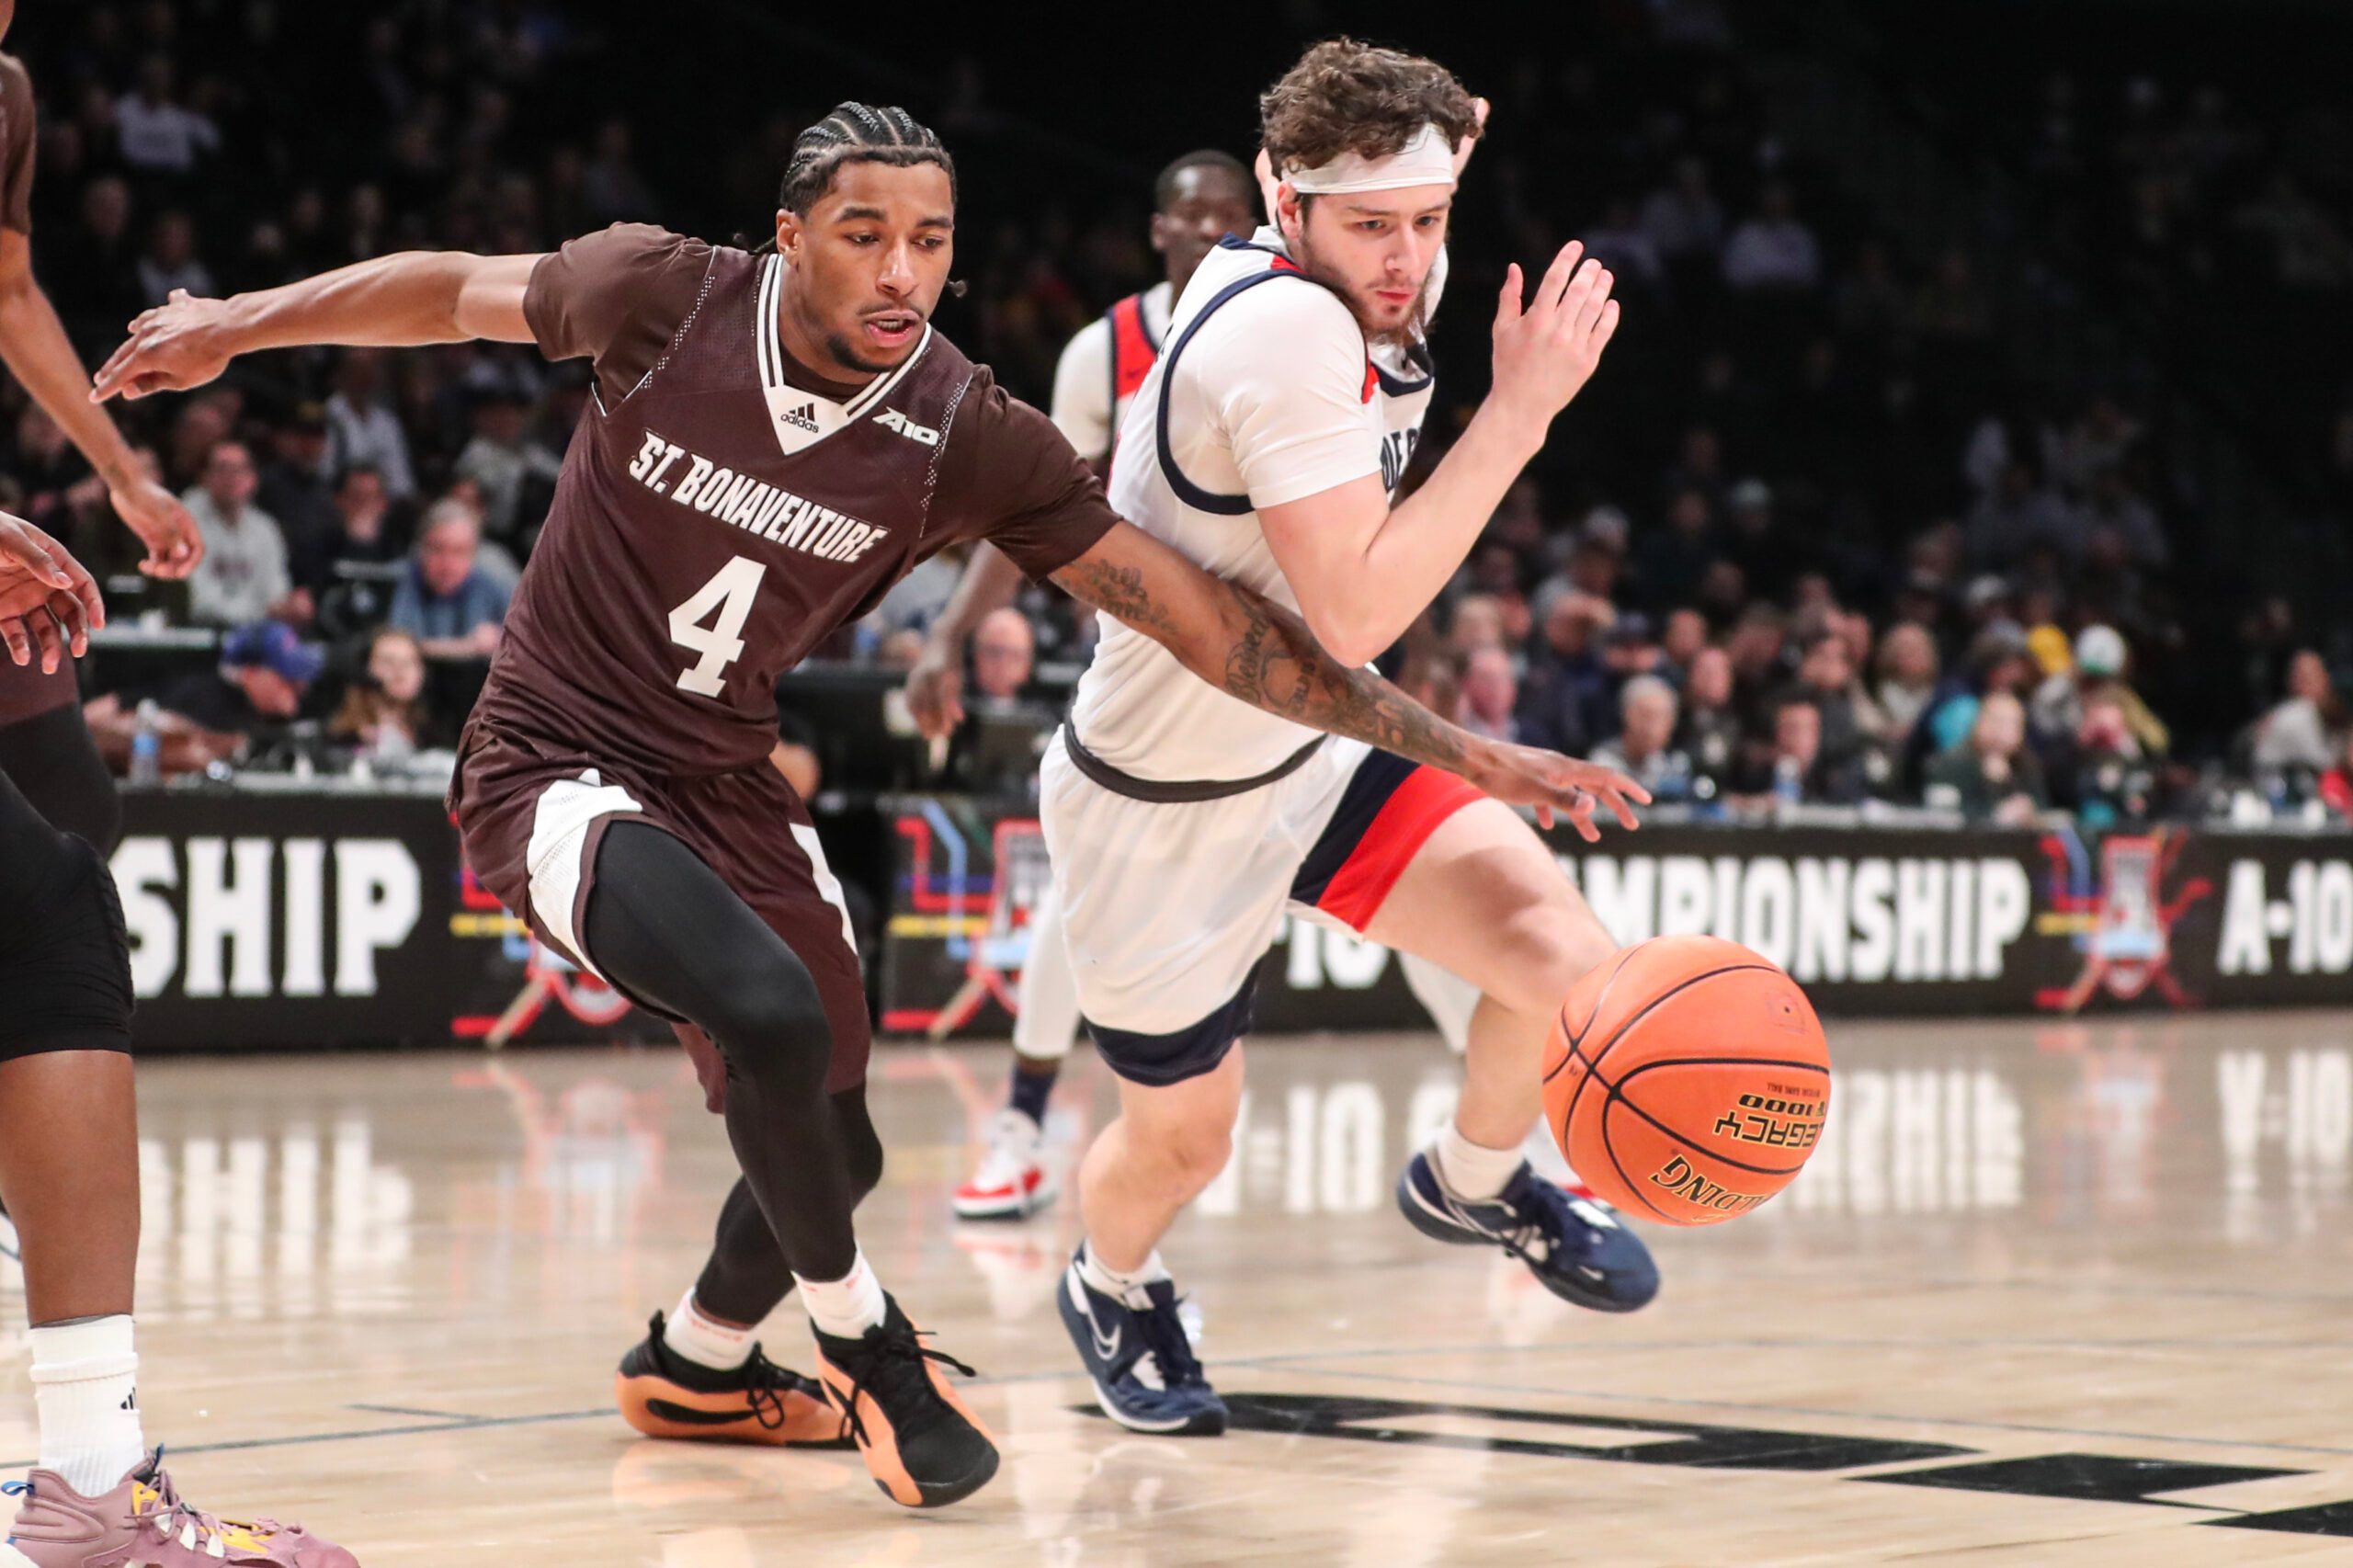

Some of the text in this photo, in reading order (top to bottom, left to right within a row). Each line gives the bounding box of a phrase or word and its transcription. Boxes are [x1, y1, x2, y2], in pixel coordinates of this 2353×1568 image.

[780, 414, 820, 434] adidas
[871, 406, 940, 447] A10
[629, 430, 890, 563] ST. BONAVENTURE
[668, 554, 767, 699] 4
[107, 836, 422, 998] SHIP
[1561, 855, 2031, 983] MPIONSHIP
[1737, 1093, 1813, 1117] 1000
